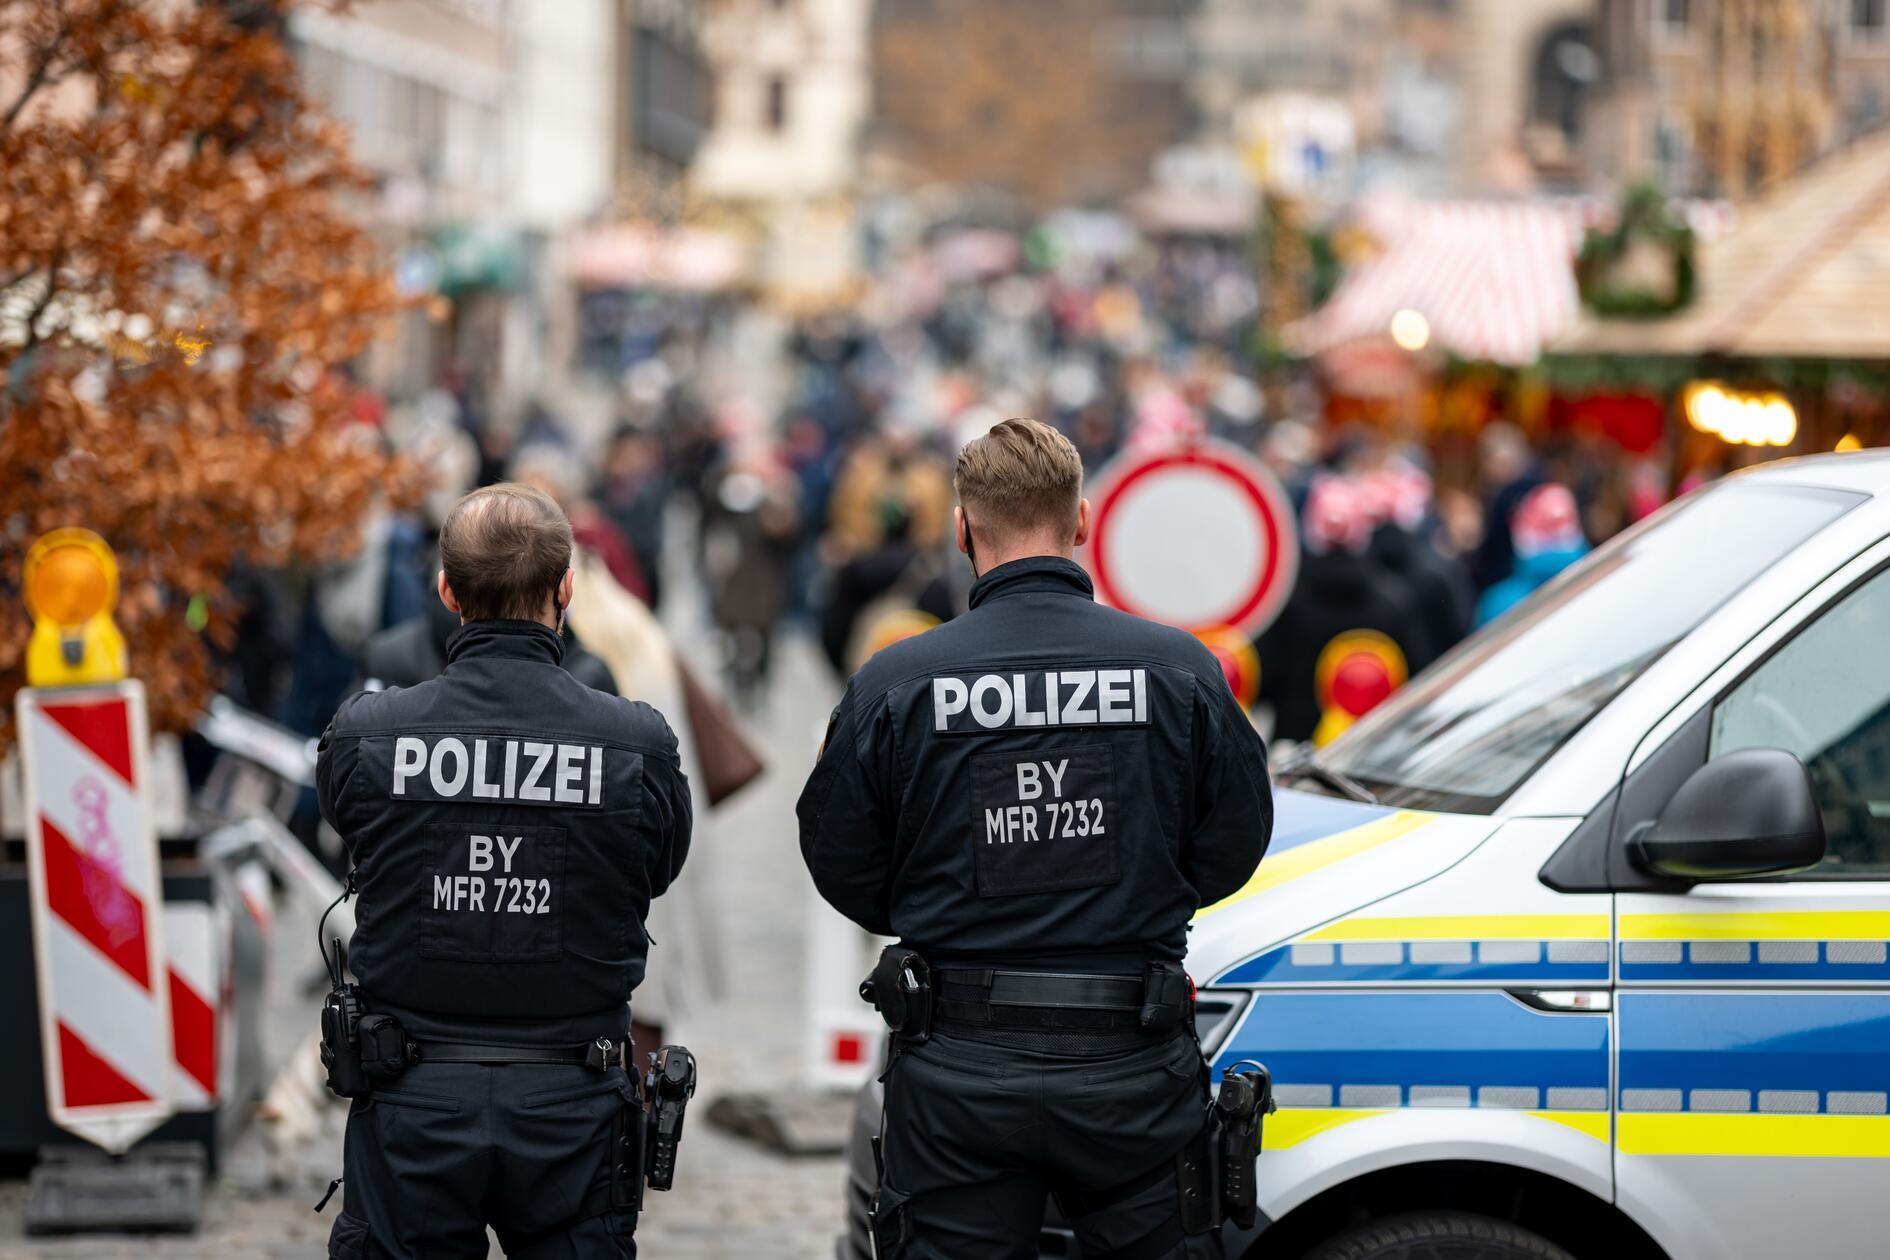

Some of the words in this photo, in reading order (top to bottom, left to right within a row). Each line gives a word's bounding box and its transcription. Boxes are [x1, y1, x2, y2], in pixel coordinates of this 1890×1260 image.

[933, 669, 1147, 731] POLIZEI
[393, 737, 603, 805] POLIZEI
[1016, 759, 1069, 801] BY
[985, 806, 1040, 845] MFR
[1045, 798, 1105, 840] 7232
[469, 836, 523, 873] BY
[433, 875, 486, 912] MFR
[493, 878, 551, 915] 7232
